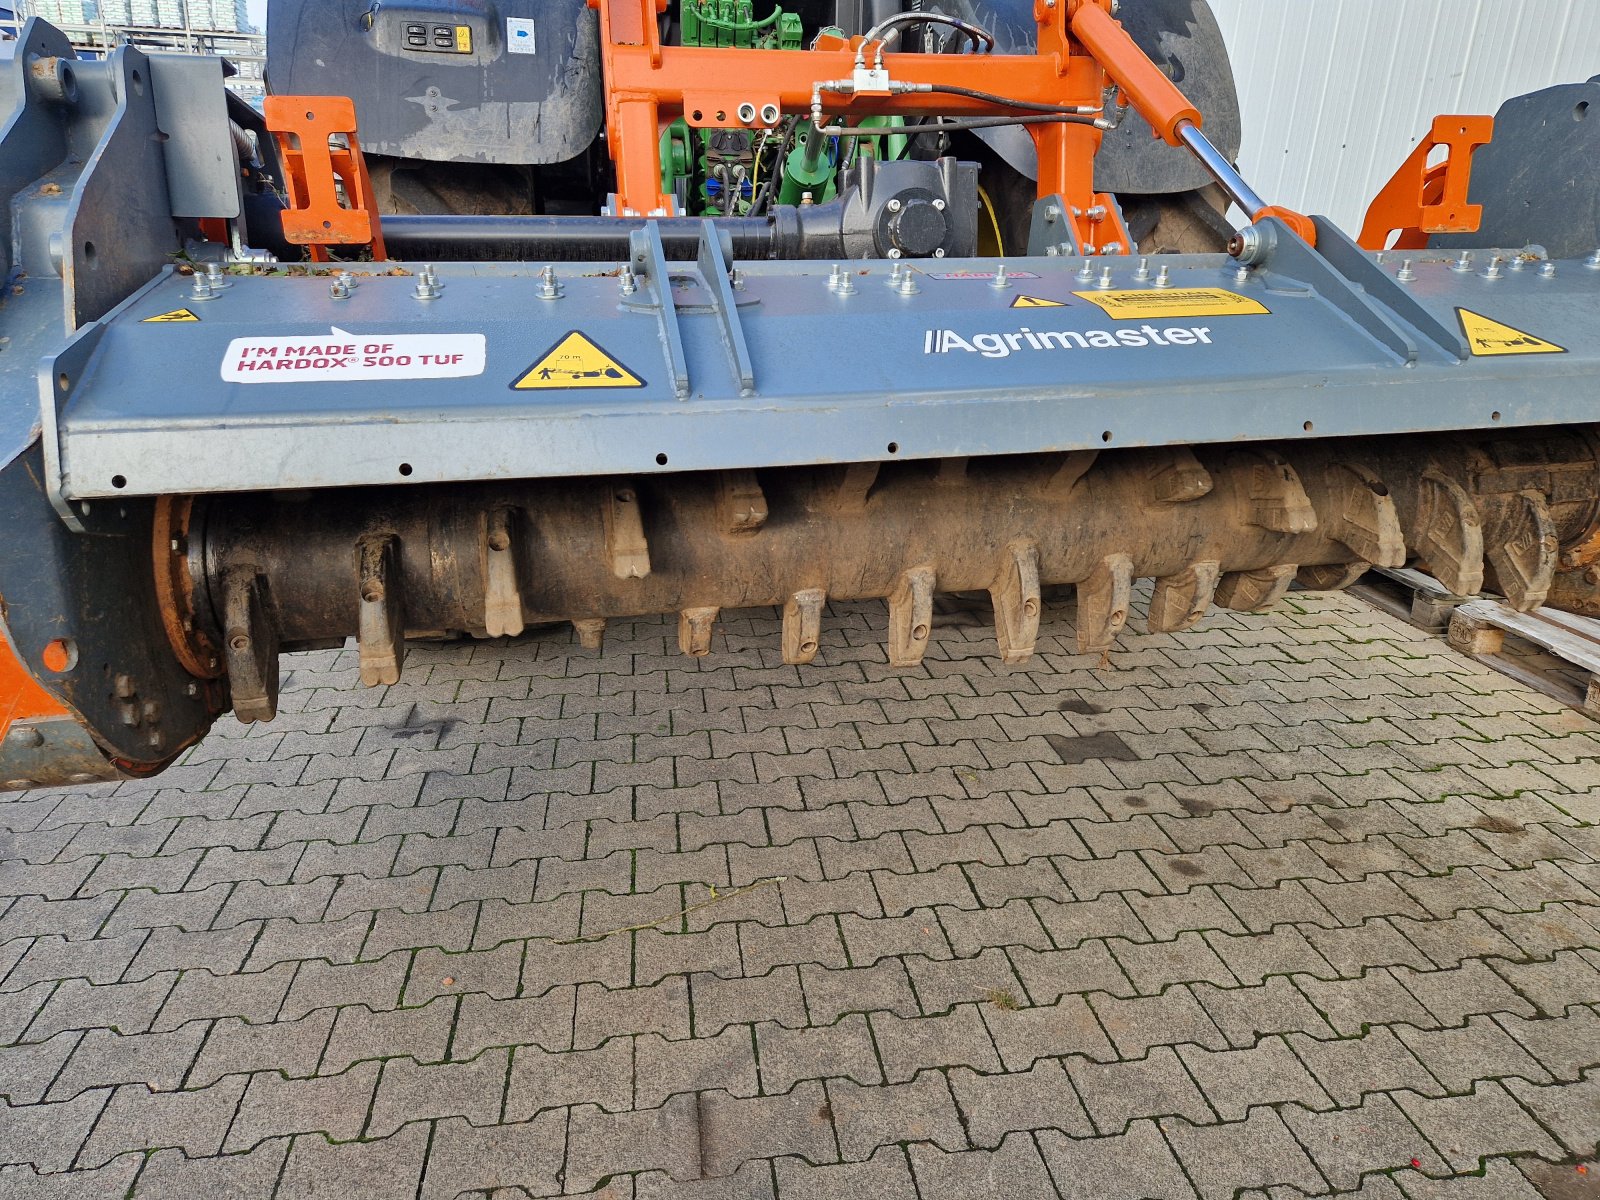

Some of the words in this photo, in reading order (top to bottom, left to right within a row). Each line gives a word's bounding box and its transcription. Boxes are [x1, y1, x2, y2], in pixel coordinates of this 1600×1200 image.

[939, 324, 1211, 358] Agrimaster
[285, 345, 356, 357] MADE
[363, 344, 395, 355] OF
[363, 356, 411, 367] 500
[418, 354, 464, 366] TUF
